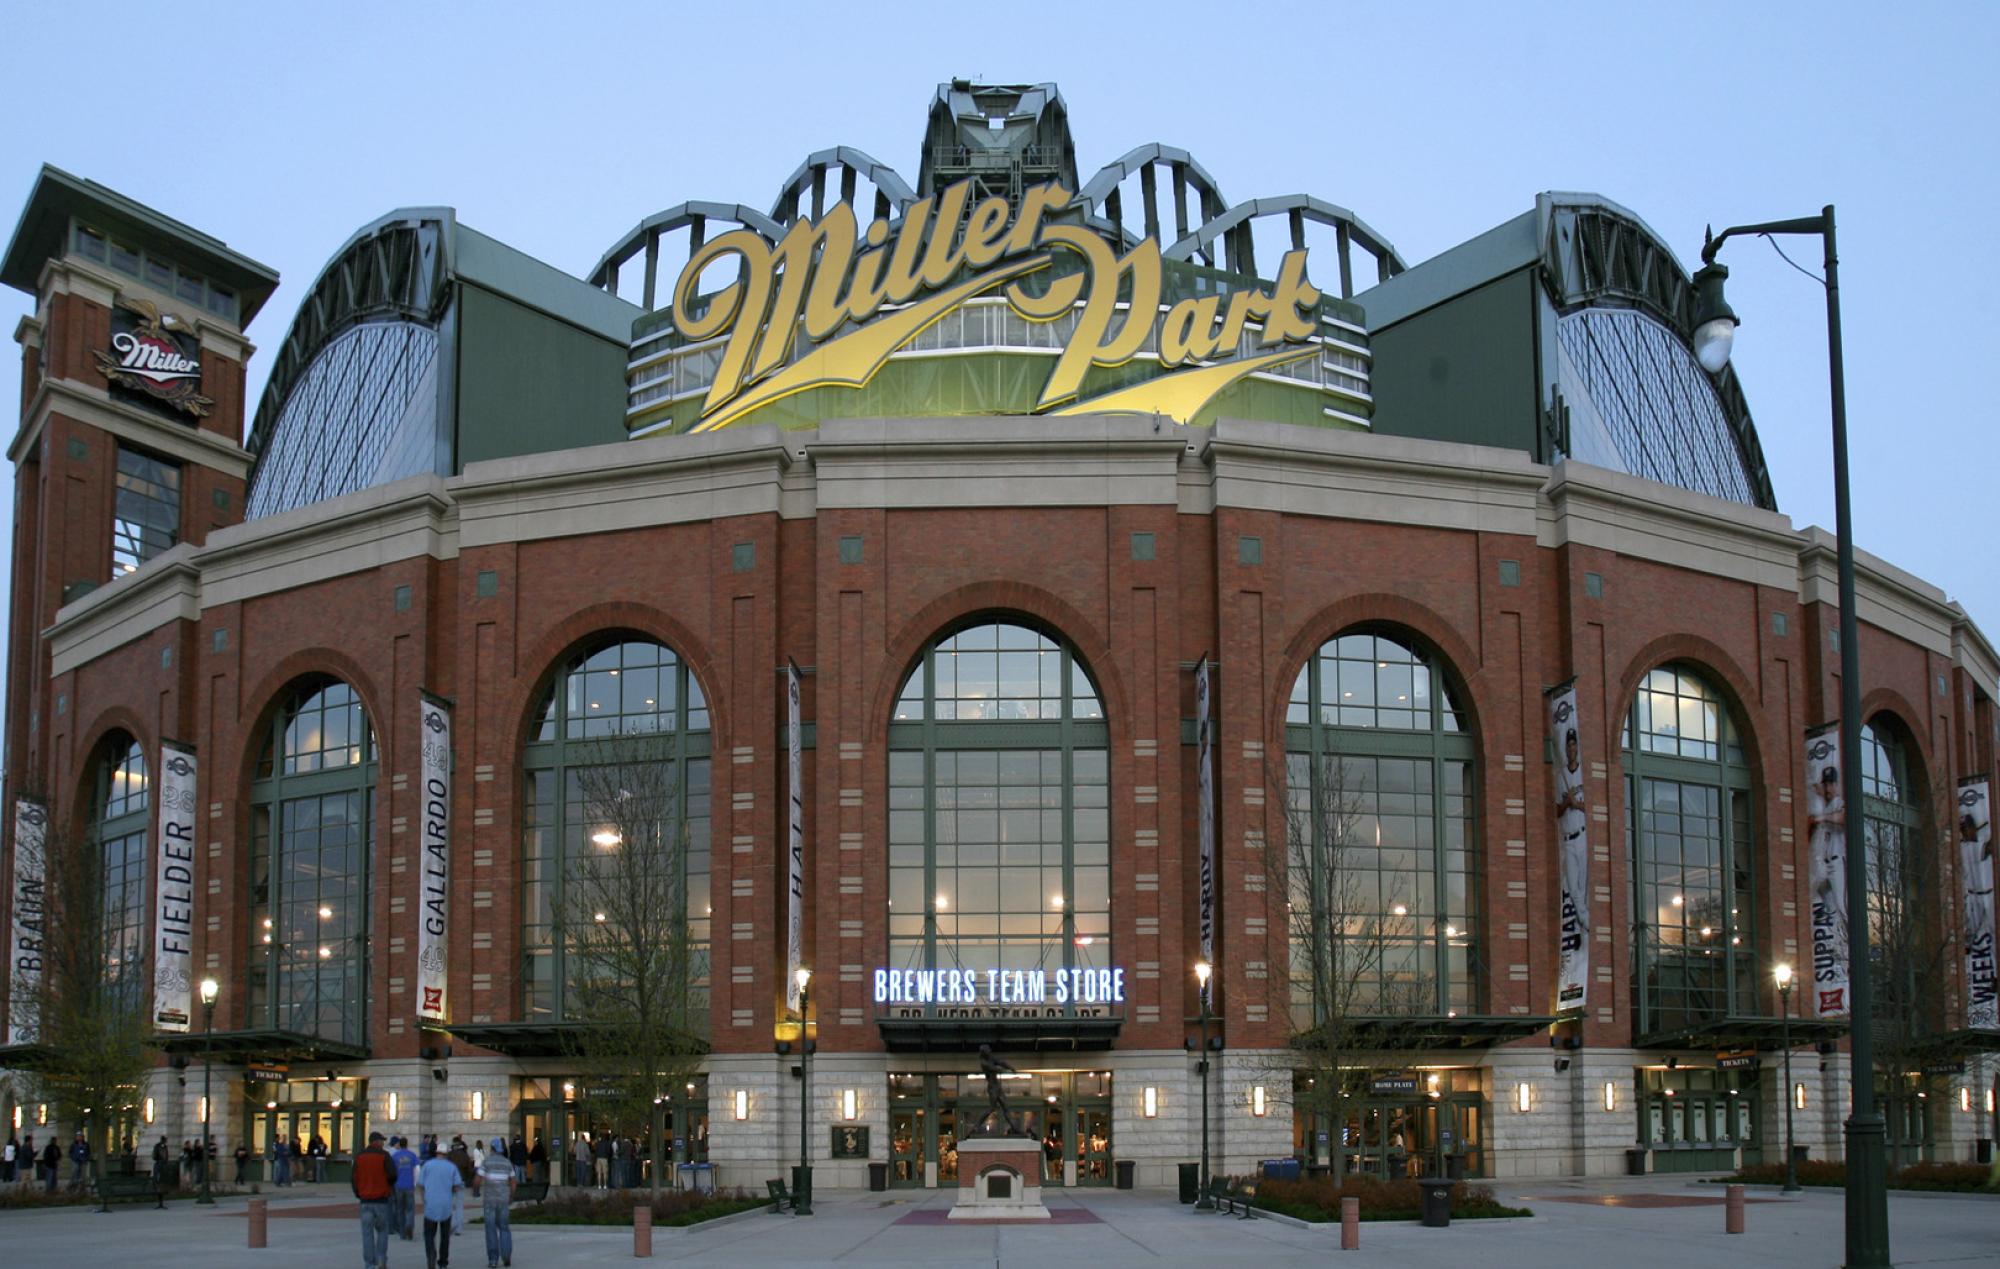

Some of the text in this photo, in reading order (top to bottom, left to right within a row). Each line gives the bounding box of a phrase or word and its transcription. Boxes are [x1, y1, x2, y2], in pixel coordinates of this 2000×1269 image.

[672, 176, 1323, 418] Miller Park
[112, 332, 200, 373] Miller
[163, 820, 193, 955] FIELDER
[426, 778, 447, 936] GALLARDO
[874, 968, 1125, 1003] BREWERS TEAM STORE
[1971, 932, 1995, 1005] WEEKS
